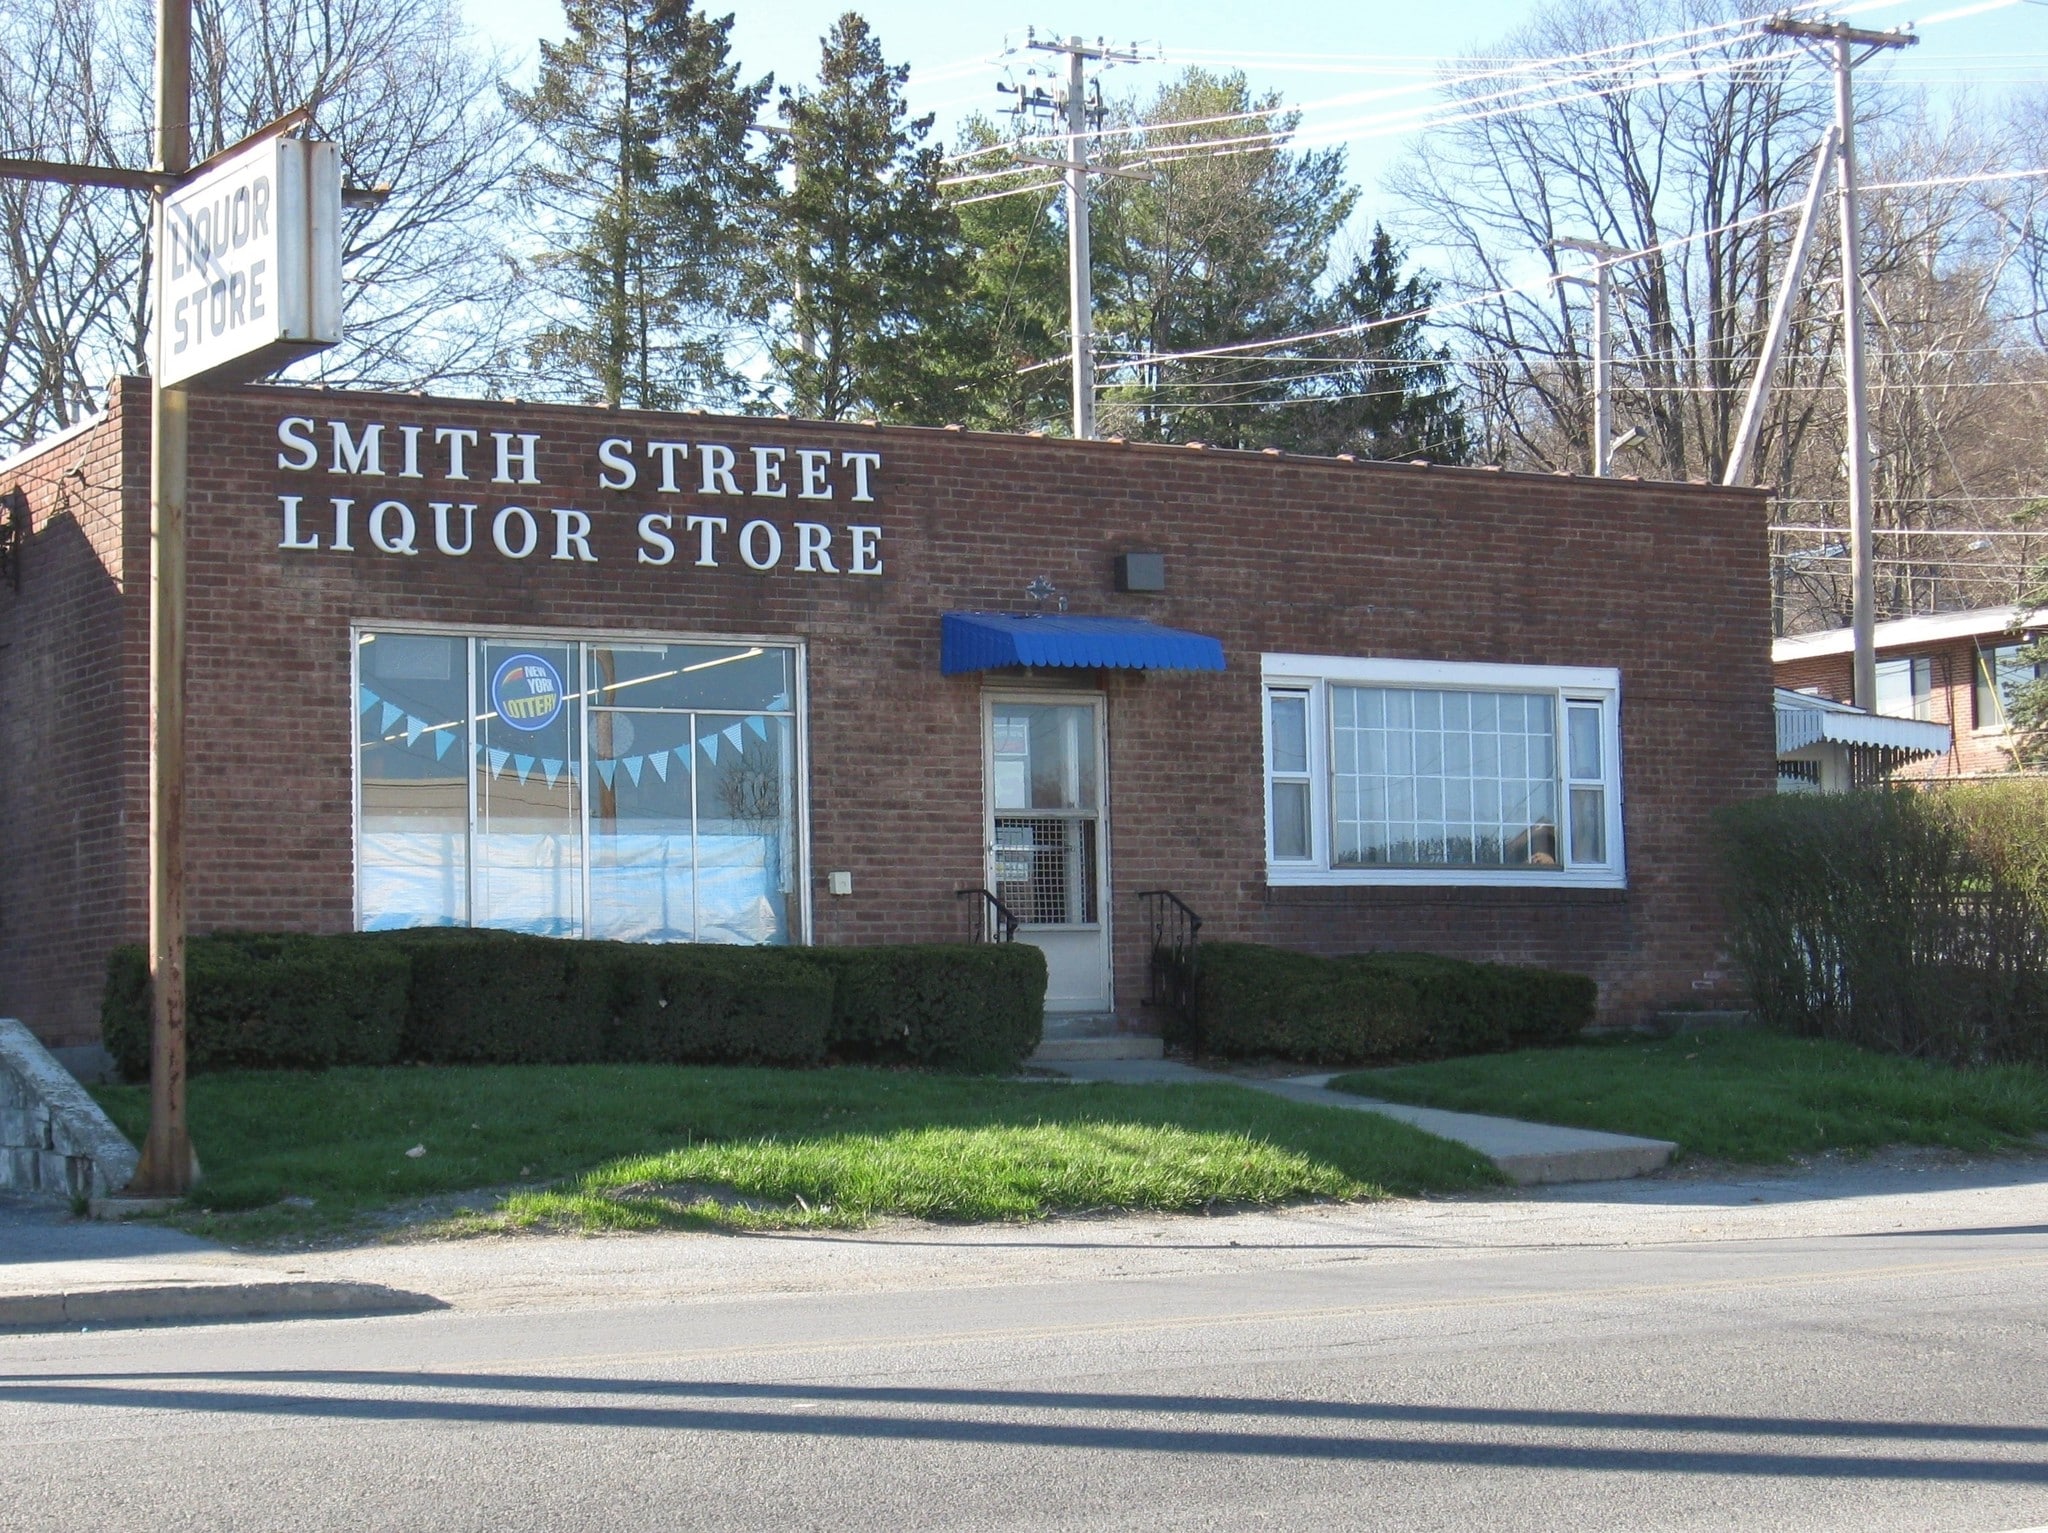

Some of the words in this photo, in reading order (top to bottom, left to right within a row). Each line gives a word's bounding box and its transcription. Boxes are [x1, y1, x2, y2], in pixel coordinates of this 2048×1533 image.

[170, 175, 270, 280] LIQUOR
[173, 258, 266, 355] STORE
[277, 416, 541, 485] SMITH
[598, 438, 881, 502] STREET
[278, 495, 599, 562] LIQUOR
[637, 513, 884, 576] STORE
[503, 693, 556, 718] LOTTERY
[524, 665, 547, 678] NEW
[527, 678, 554, 694] YORK
